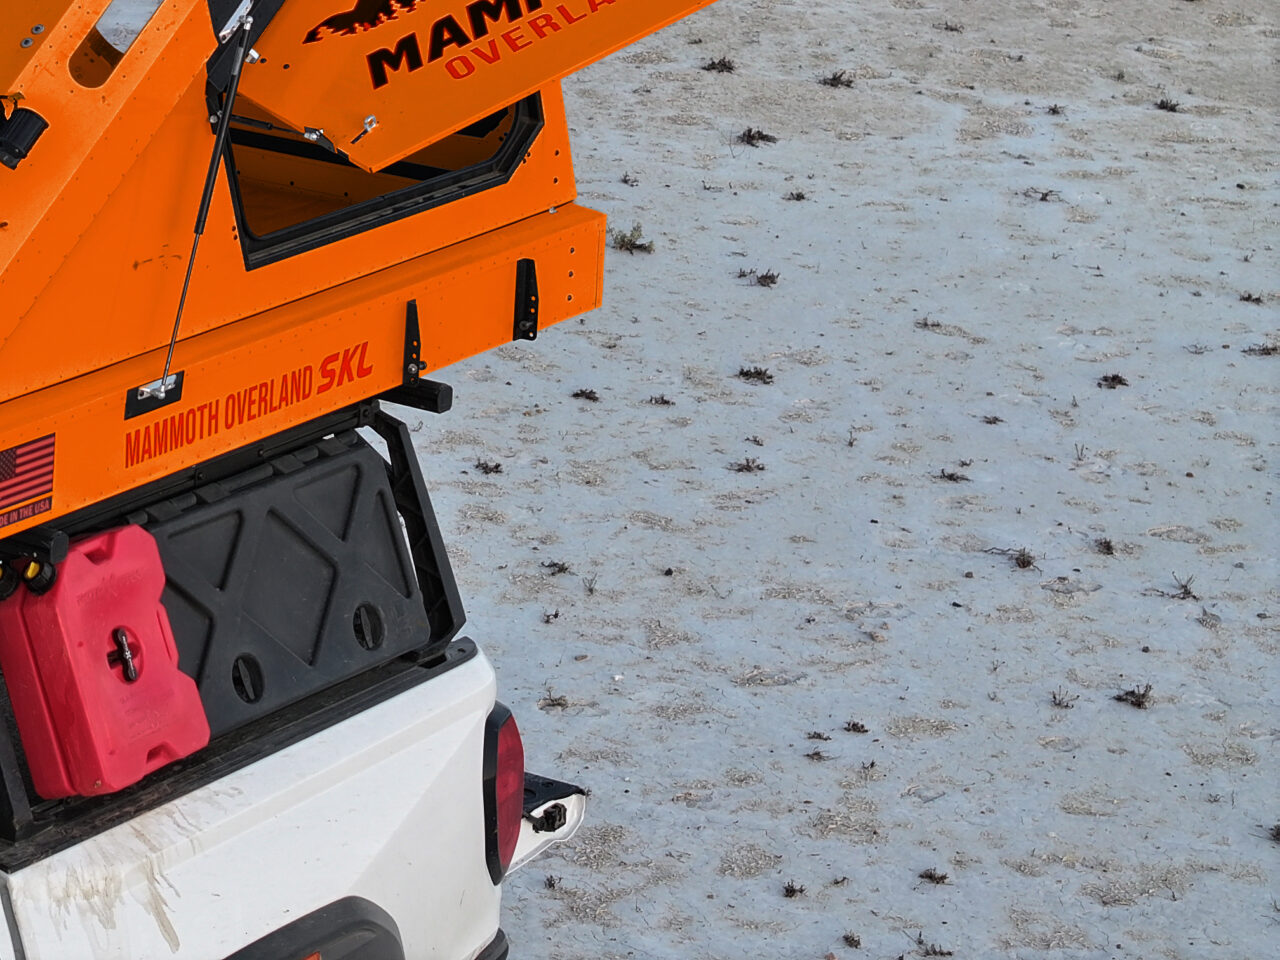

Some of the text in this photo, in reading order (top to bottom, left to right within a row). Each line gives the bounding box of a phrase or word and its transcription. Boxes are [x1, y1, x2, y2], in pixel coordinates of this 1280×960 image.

[125, 341, 374, 470] MAMMOTH OVERLAND SKL
[10, 511, 18, 523] IN
[19, 505, 33, 519] THE
[34, 498, 50, 512] USA
